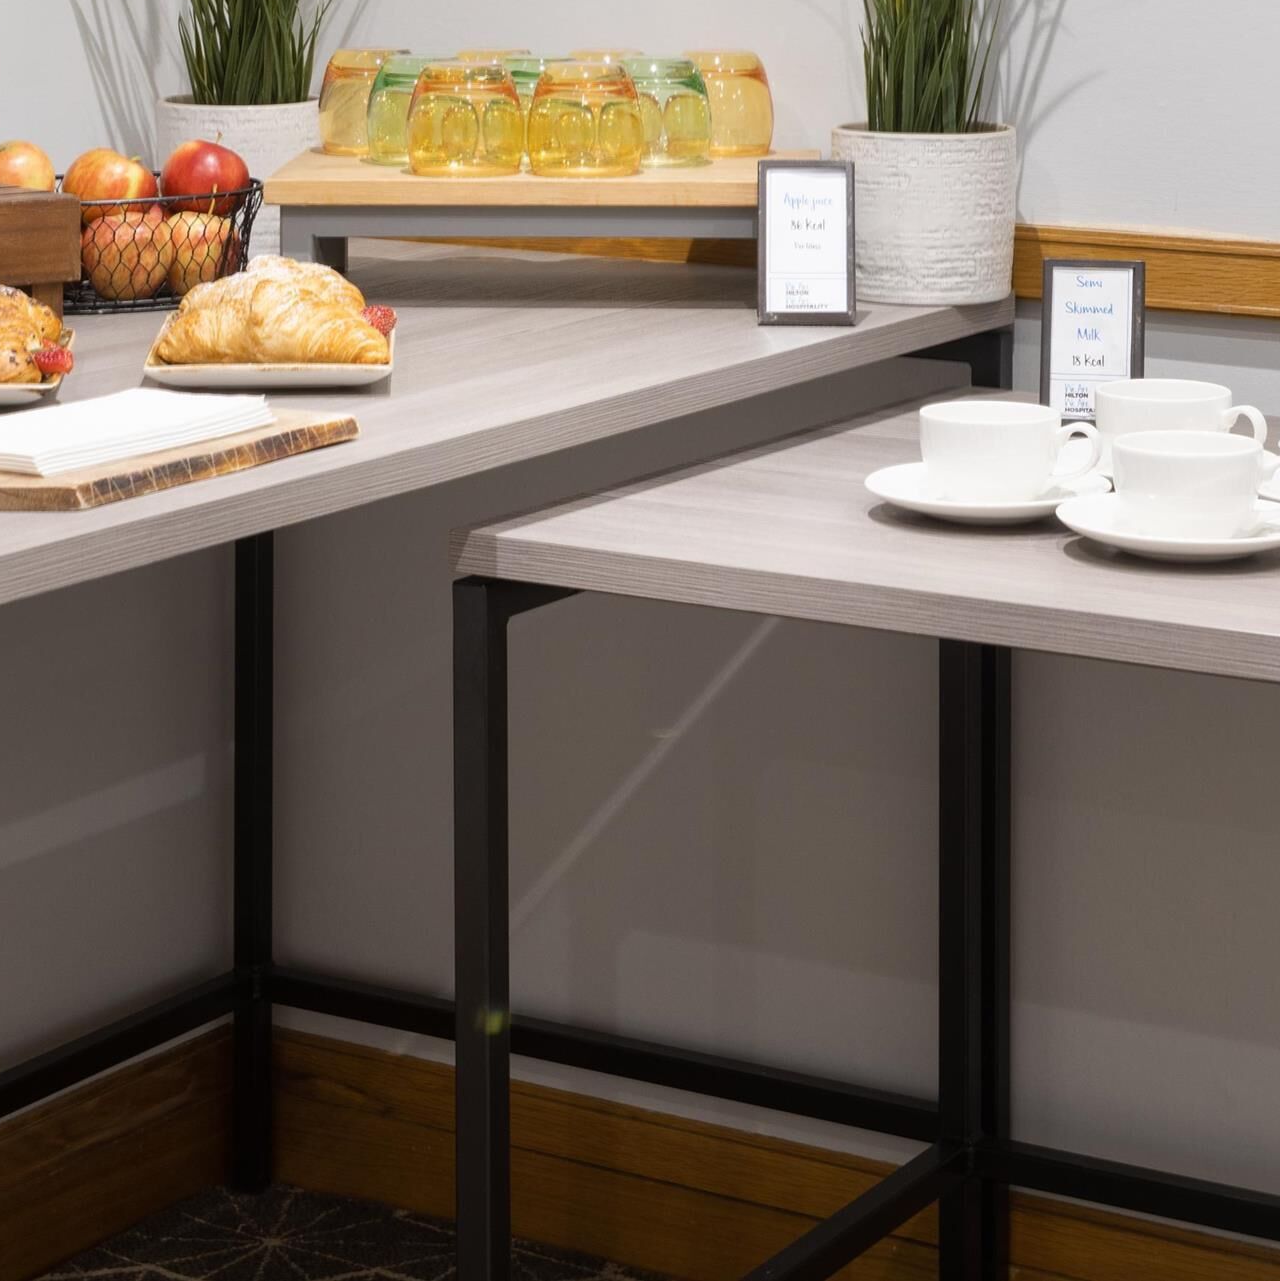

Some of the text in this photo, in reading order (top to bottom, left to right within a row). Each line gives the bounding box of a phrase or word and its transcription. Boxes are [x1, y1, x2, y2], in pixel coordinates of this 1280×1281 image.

[783, 191, 809, 210] Apple
[805, 217, 826, 232] Kcal
[1075, 275, 1103, 289] Semi
[1065, 301, 1114, 316] Skimmed
[1076, 327, 1102, 342] Milk
[1072, 353, 1105, 367] 18 Kcal
